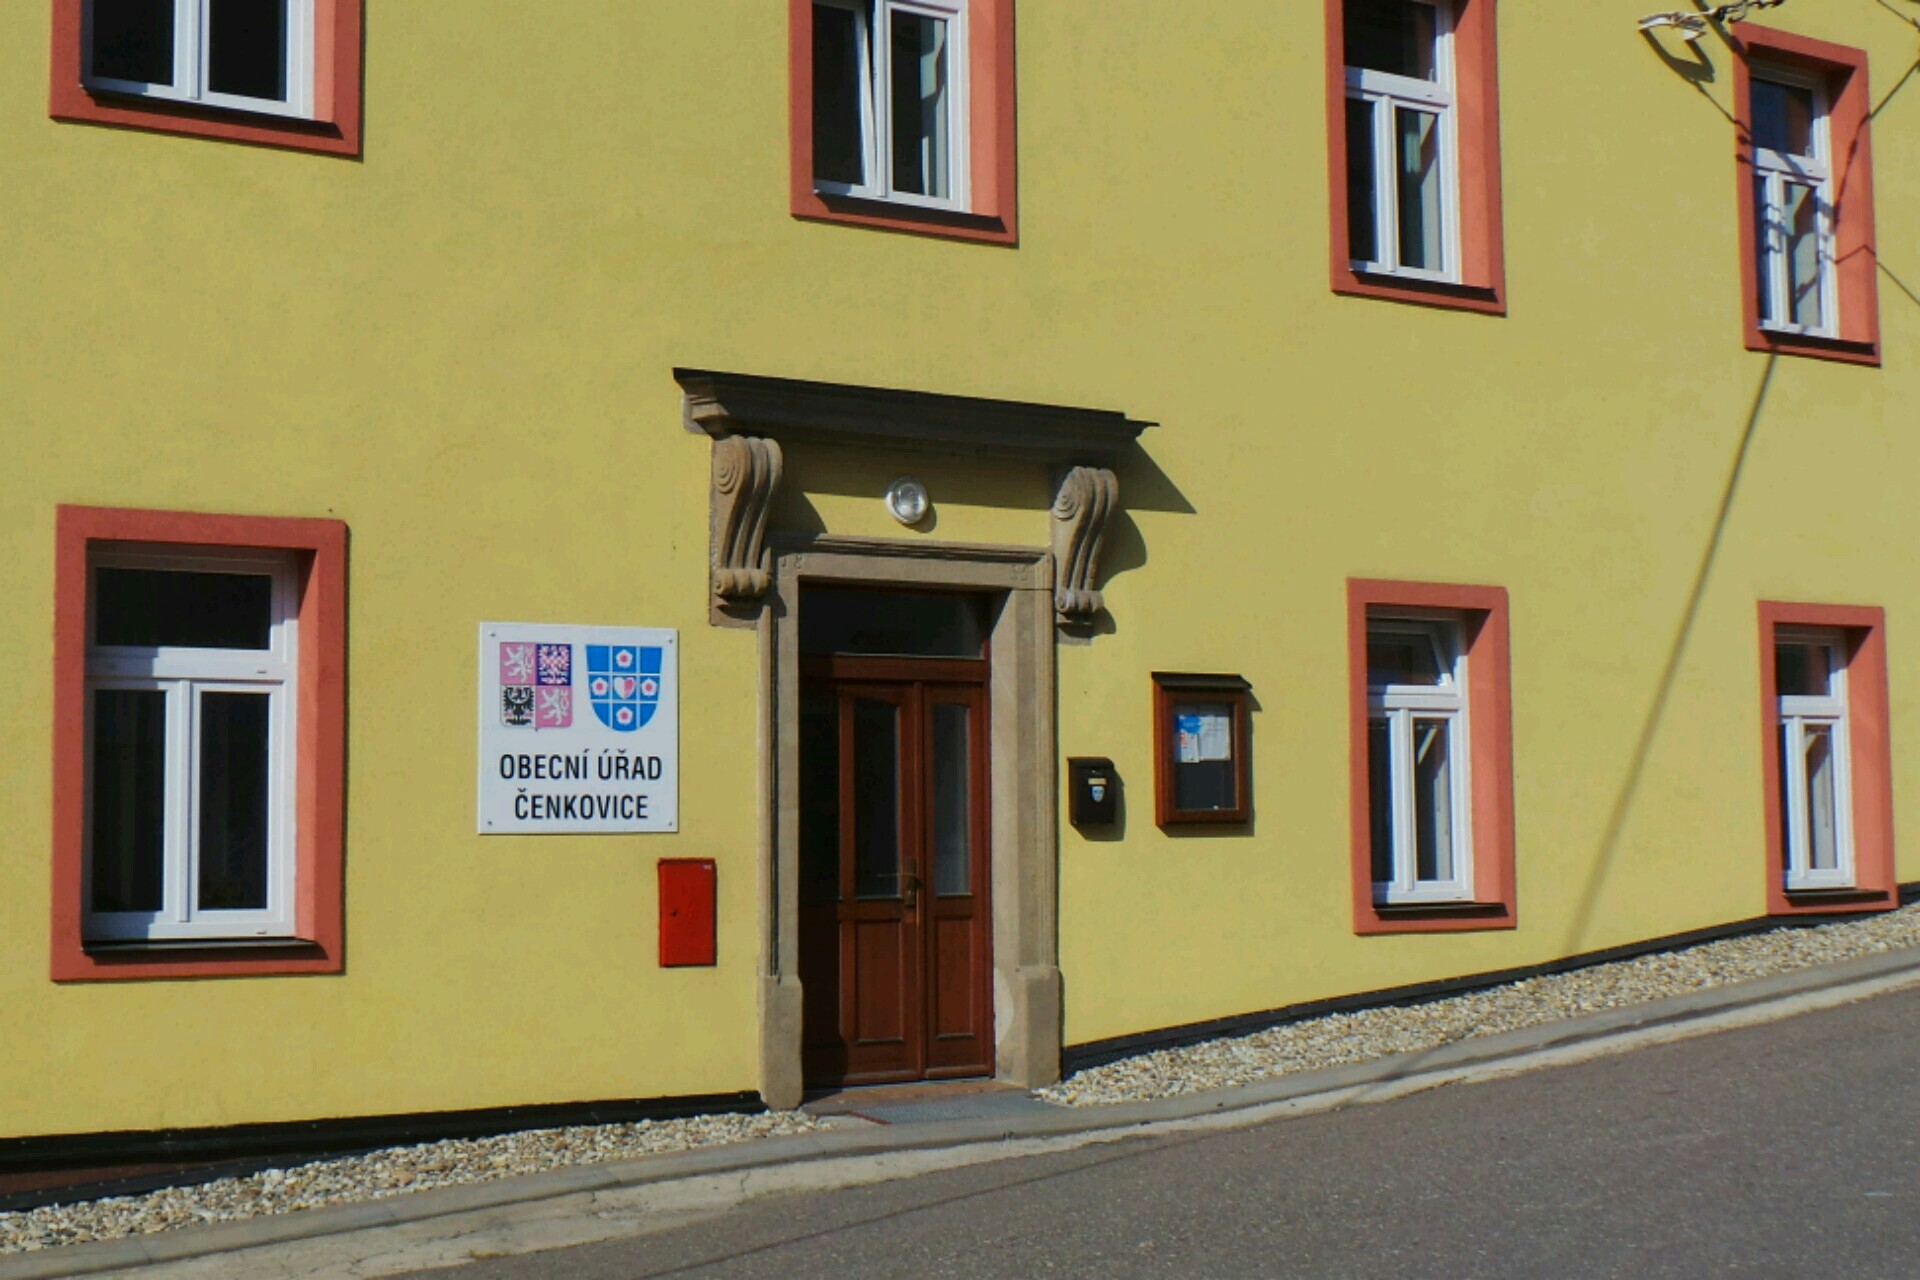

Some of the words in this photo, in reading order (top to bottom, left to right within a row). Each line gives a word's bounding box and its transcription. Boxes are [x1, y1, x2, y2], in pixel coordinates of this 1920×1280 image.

[500, 748, 590, 780] OBECNÍ
[597, 748, 662, 780] ÚŘAD
[514, 787, 648, 819] ČENKOVICE
